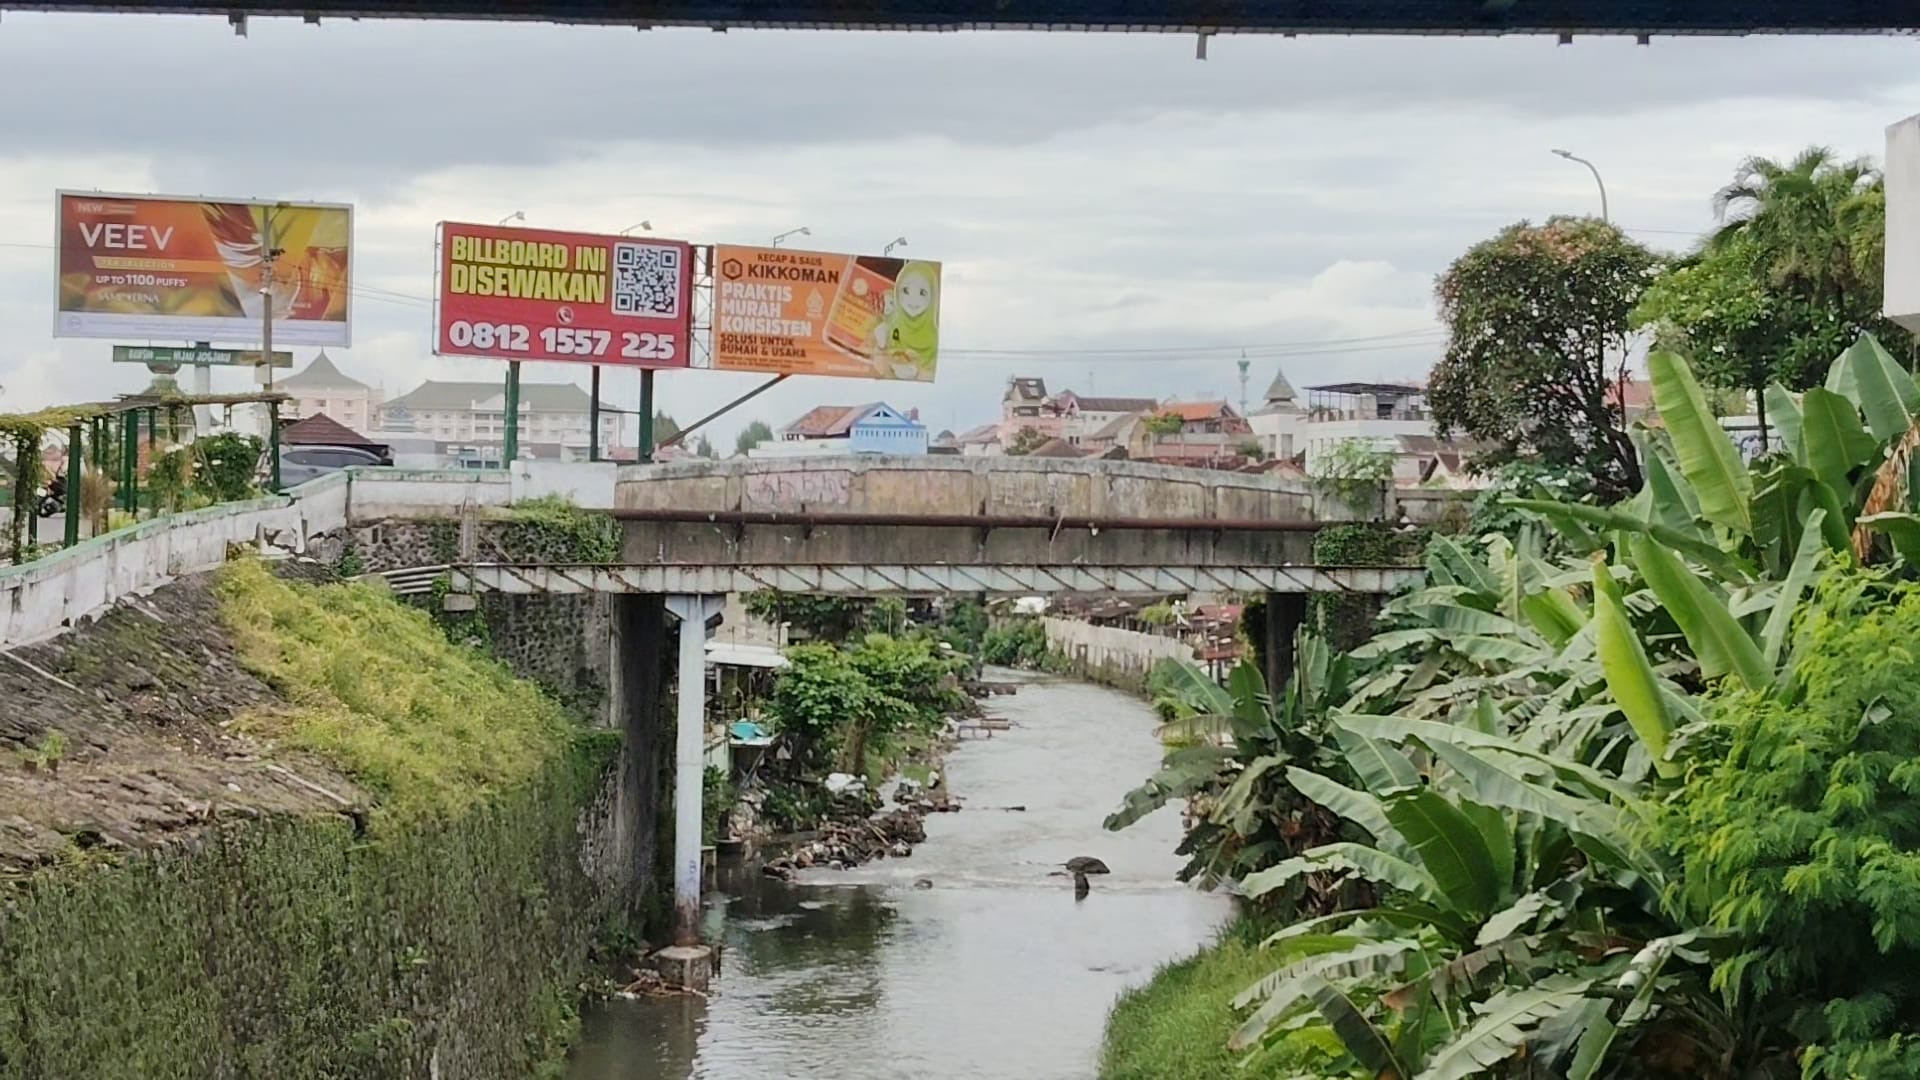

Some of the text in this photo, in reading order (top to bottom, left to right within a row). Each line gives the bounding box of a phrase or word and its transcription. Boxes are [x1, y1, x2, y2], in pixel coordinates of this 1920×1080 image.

[79, 222, 174, 251] VEEV
[451, 235, 607, 272] BILLBOARD INI
[757, 253, 788, 263] KECAP
[95, 275, 110, 284] UP
[111, 276, 125, 285] TO
[126, 274, 155, 286] 1100
[450, 264, 605, 303] DISEWAKAN
[747, 263, 839, 284] KIKKOMAN
[722, 282, 791, 301] PRAKTIS
[722, 298, 781, 318] MURAH
[721, 315, 812, 337] KONSISTEN
[449, 320, 675, 360] 0812 1557 225
[719, 333, 794, 346] SOLUSI UNTUK
[719, 343, 758, 355] RUMAH
[772, 347, 807, 358] USAHA
